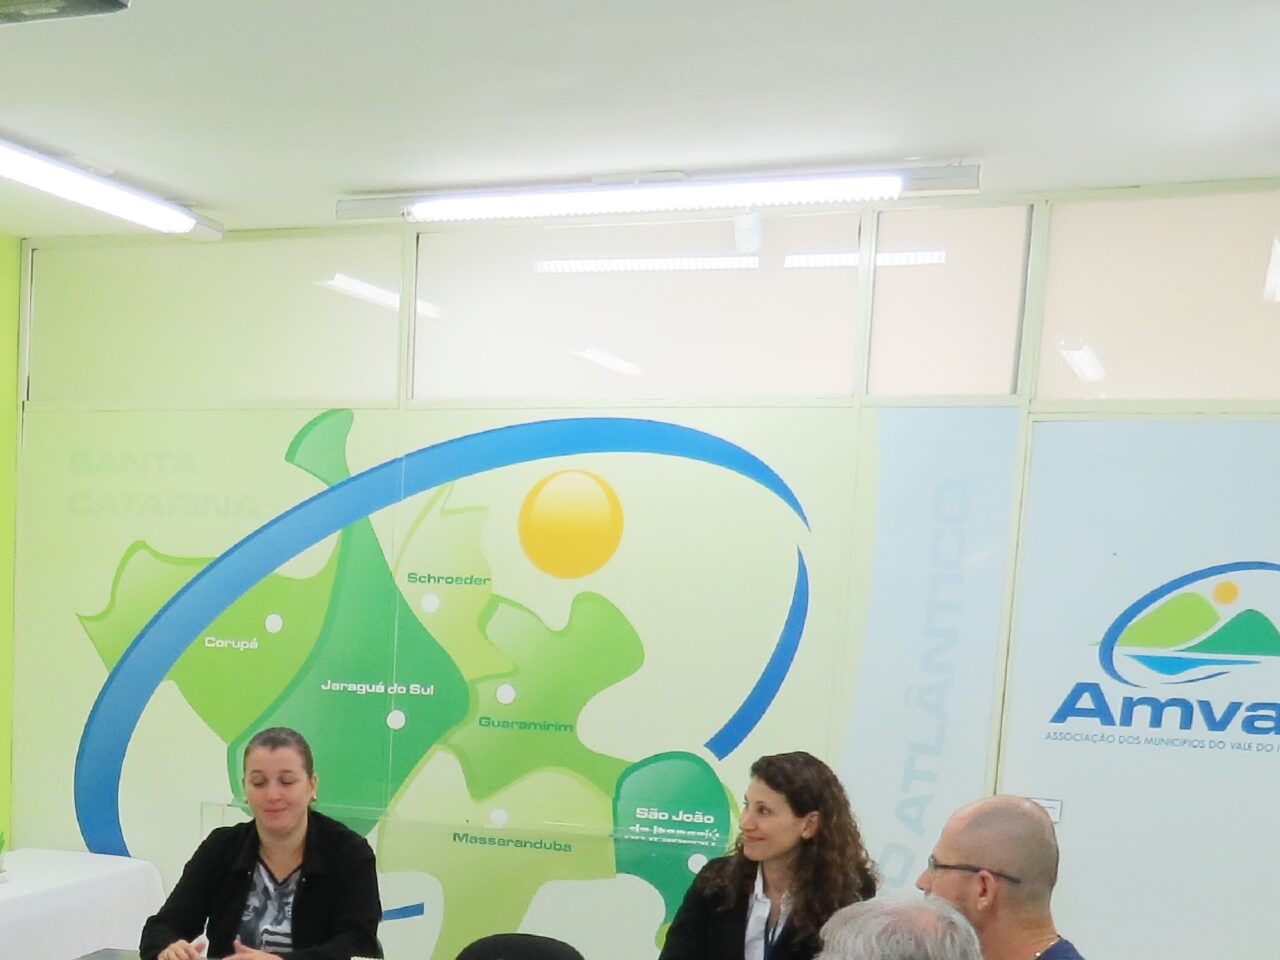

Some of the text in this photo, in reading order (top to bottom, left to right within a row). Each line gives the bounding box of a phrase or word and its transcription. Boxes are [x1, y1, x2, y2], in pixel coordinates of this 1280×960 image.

[68, 449, 198, 475] SANTA
[67, 490, 262, 518] CATARINA
[407, 572, 491, 586] Schroeder
[204, 636, 259, 651] Corupá
[895, 478, 973, 839] ATLÂNTICO
[321, 679, 434, 696] Jaraguá do Sul
[1049, 682, 1280, 736] Amva
[478, 716, 574, 733] Guaramirim
[1045, 731, 1115, 745] ASSOCIAÇÃO
[1119, 735, 1141, 745] DOS
[1209, 740, 1225, 750] DO
[1230, 742, 1252, 752] VALE
[1256, 743, 1274, 753] DO
[636, 807, 715, 824] São João
[452, 832, 573, 853] Massaranduba
